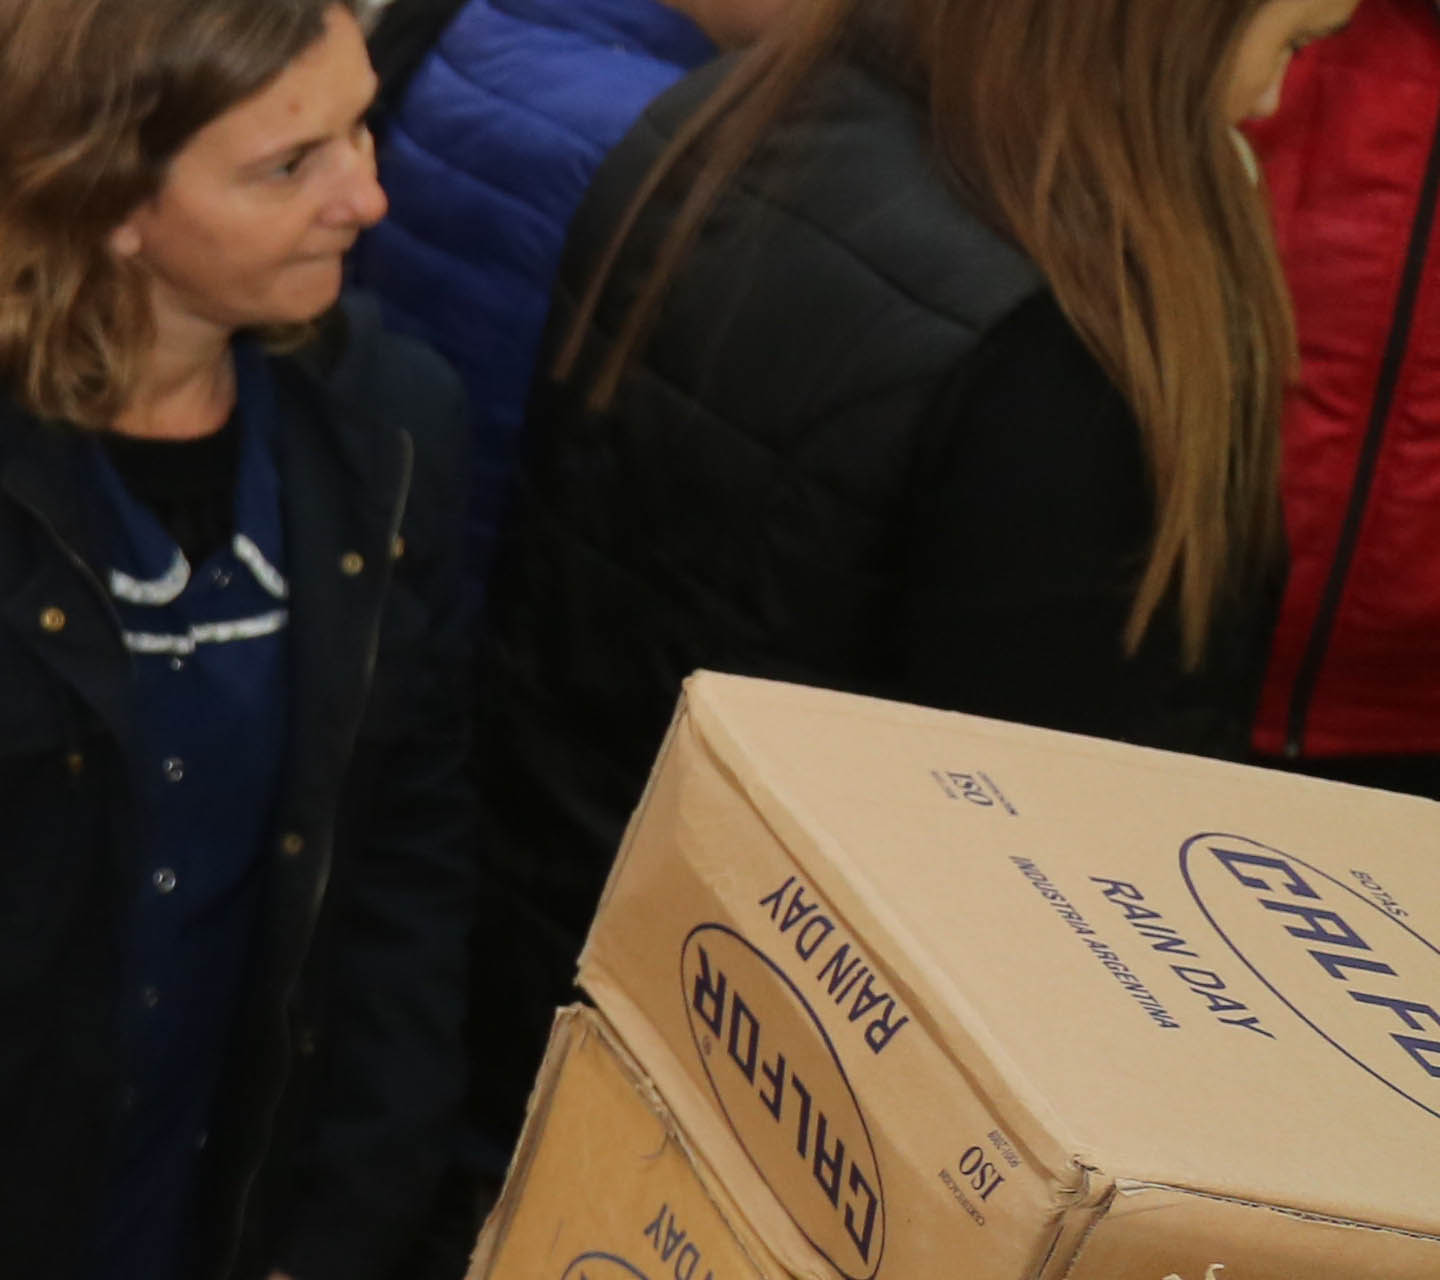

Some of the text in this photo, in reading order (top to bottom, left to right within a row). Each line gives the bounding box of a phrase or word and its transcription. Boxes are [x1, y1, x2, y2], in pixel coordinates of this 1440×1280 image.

[758, 876, 910, 1055] RAIN DAY
[1009, 855, 1180, 1029] INDUSTRIA ARGENTINA
[1089, 876, 1277, 1040] RAIN DAY
[1351, 869, 1408, 919] BOTAS
[692, 945, 879, 1266] CALFOR
[959, 1146, 1006, 1202] ISO
